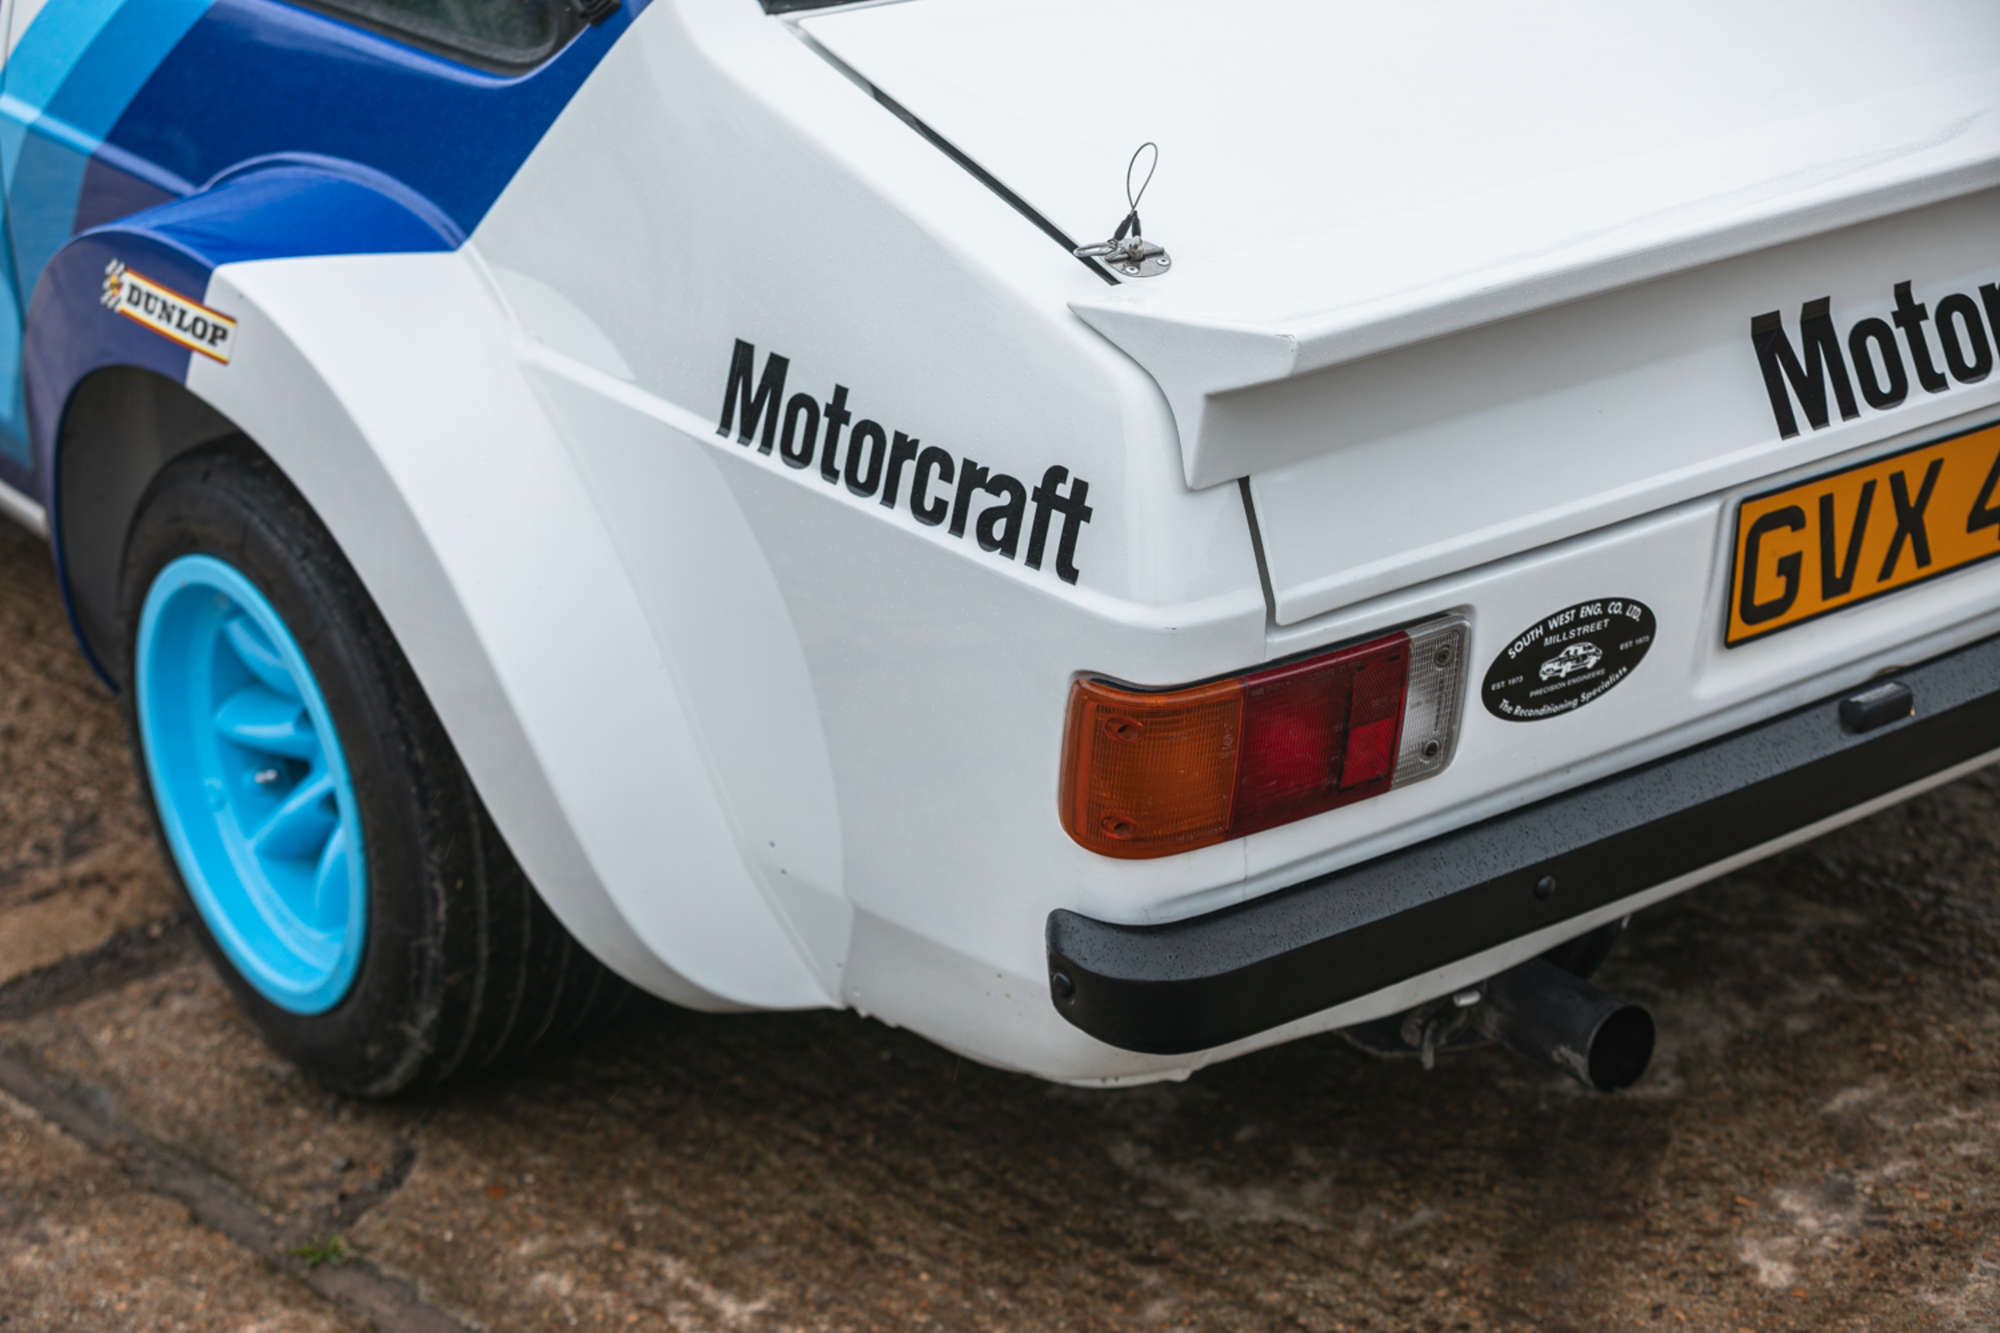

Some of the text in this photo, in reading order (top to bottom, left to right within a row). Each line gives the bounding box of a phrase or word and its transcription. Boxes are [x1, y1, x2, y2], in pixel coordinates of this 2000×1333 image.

[126, 283, 229, 347] DUNLOP
[715, 337, 1093, 586] Motorcraft
[1739, 457, 1945, 626] GVX
[1507, 624, 1544, 660] SOUTH
[1547, 609, 1576, 631] WEST
[1579, 602, 1604, 619] ENG.
[1607, 601, 1623, 615] CO.
[1543, 618, 1610, 647] MILLSTREET
[1499, 666, 1628, 717] The Reconditioning Specialists
[1529, 667, 1606, 698] PRECISION ENGINEERS
